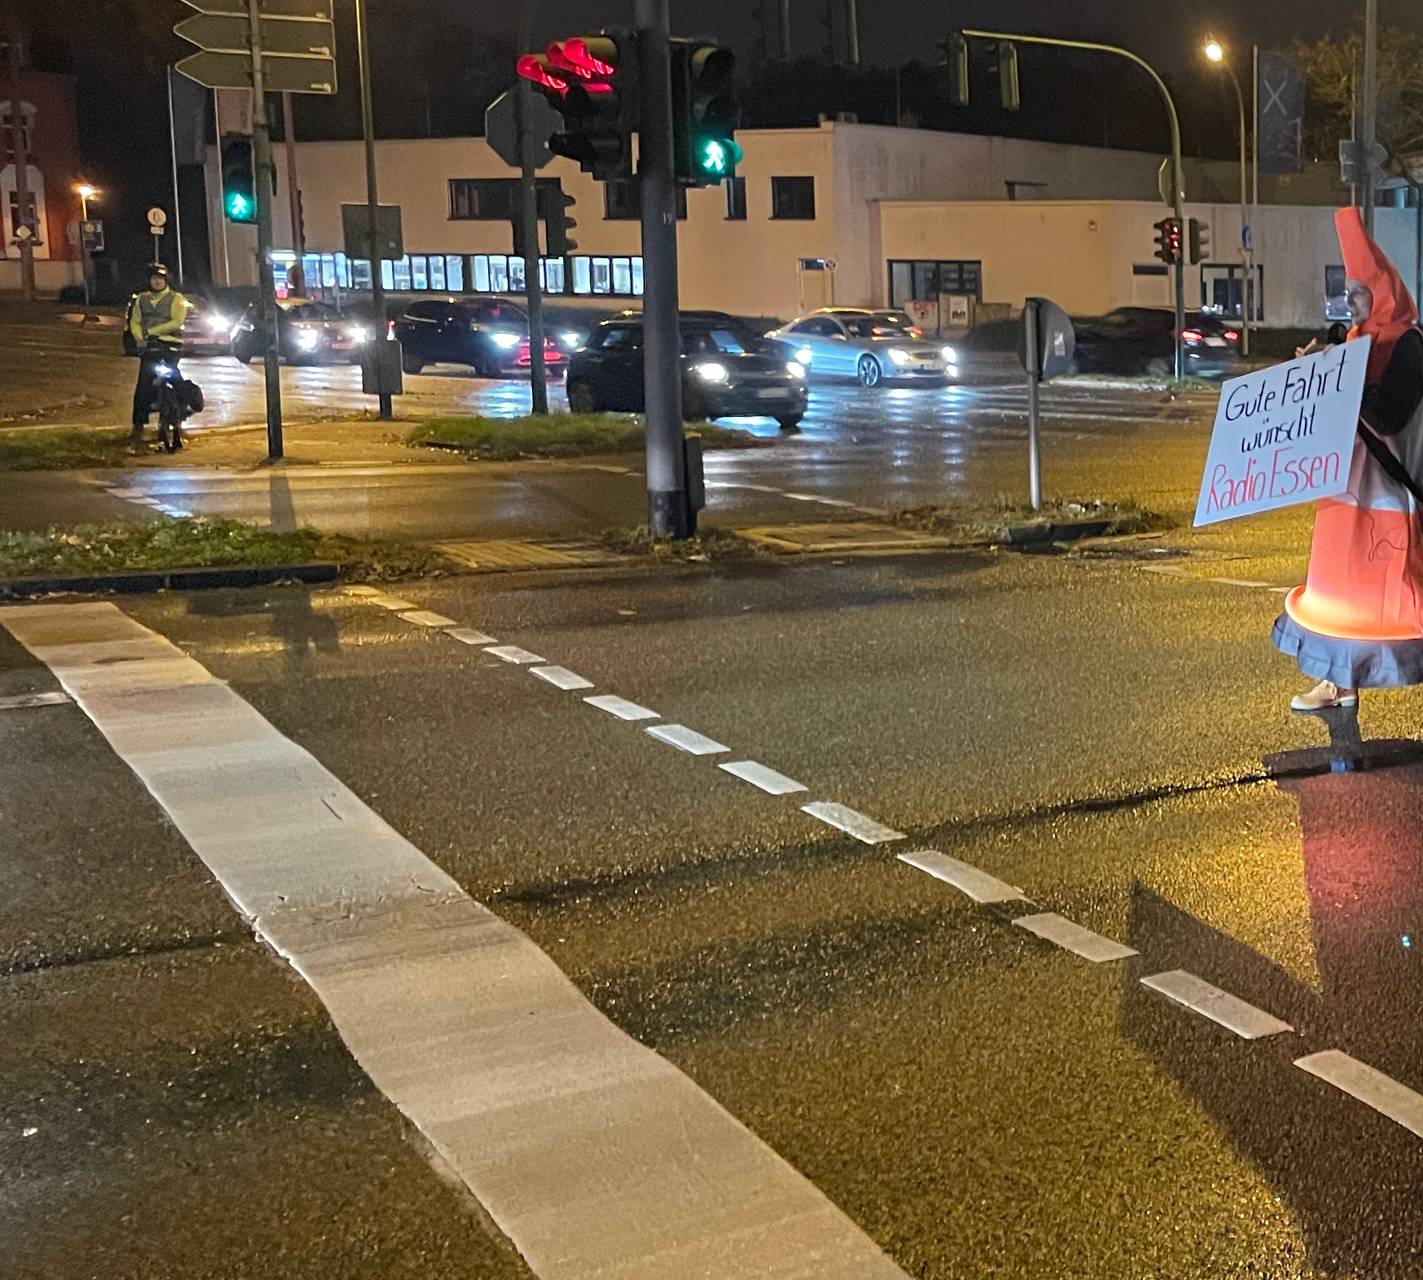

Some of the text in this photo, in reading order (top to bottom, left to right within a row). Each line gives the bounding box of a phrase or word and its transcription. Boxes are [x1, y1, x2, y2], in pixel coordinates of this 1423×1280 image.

[1225, 349, 1348, 422] Gute Fahrt
[1241, 403, 1316, 453] wünscht
[1206, 446, 1340, 514] Radio Essen
